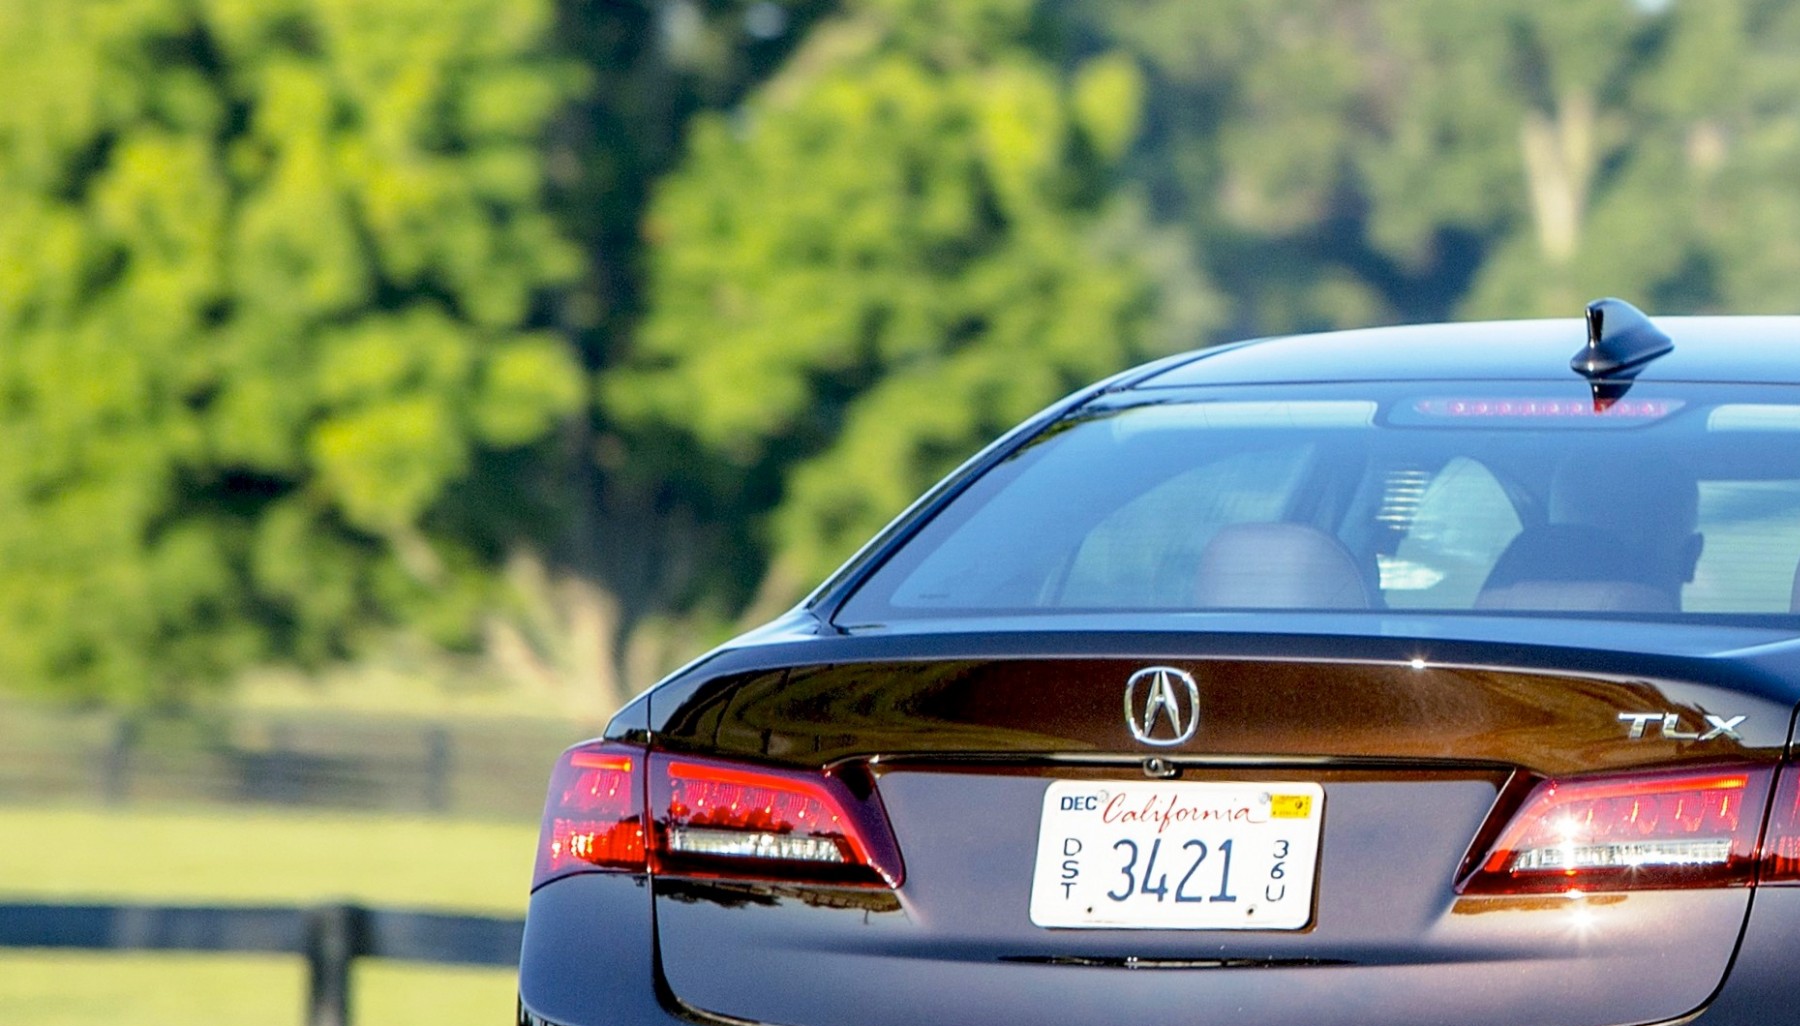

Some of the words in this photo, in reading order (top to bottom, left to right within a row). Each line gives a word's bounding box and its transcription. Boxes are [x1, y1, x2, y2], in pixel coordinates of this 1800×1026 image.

[1618, 712, 1748, 740] TLX
[1060, 796, 1098, 811] DEC
[1103, 792, 1267, 834] California
[1107, 838, 1238, 903] 3421
